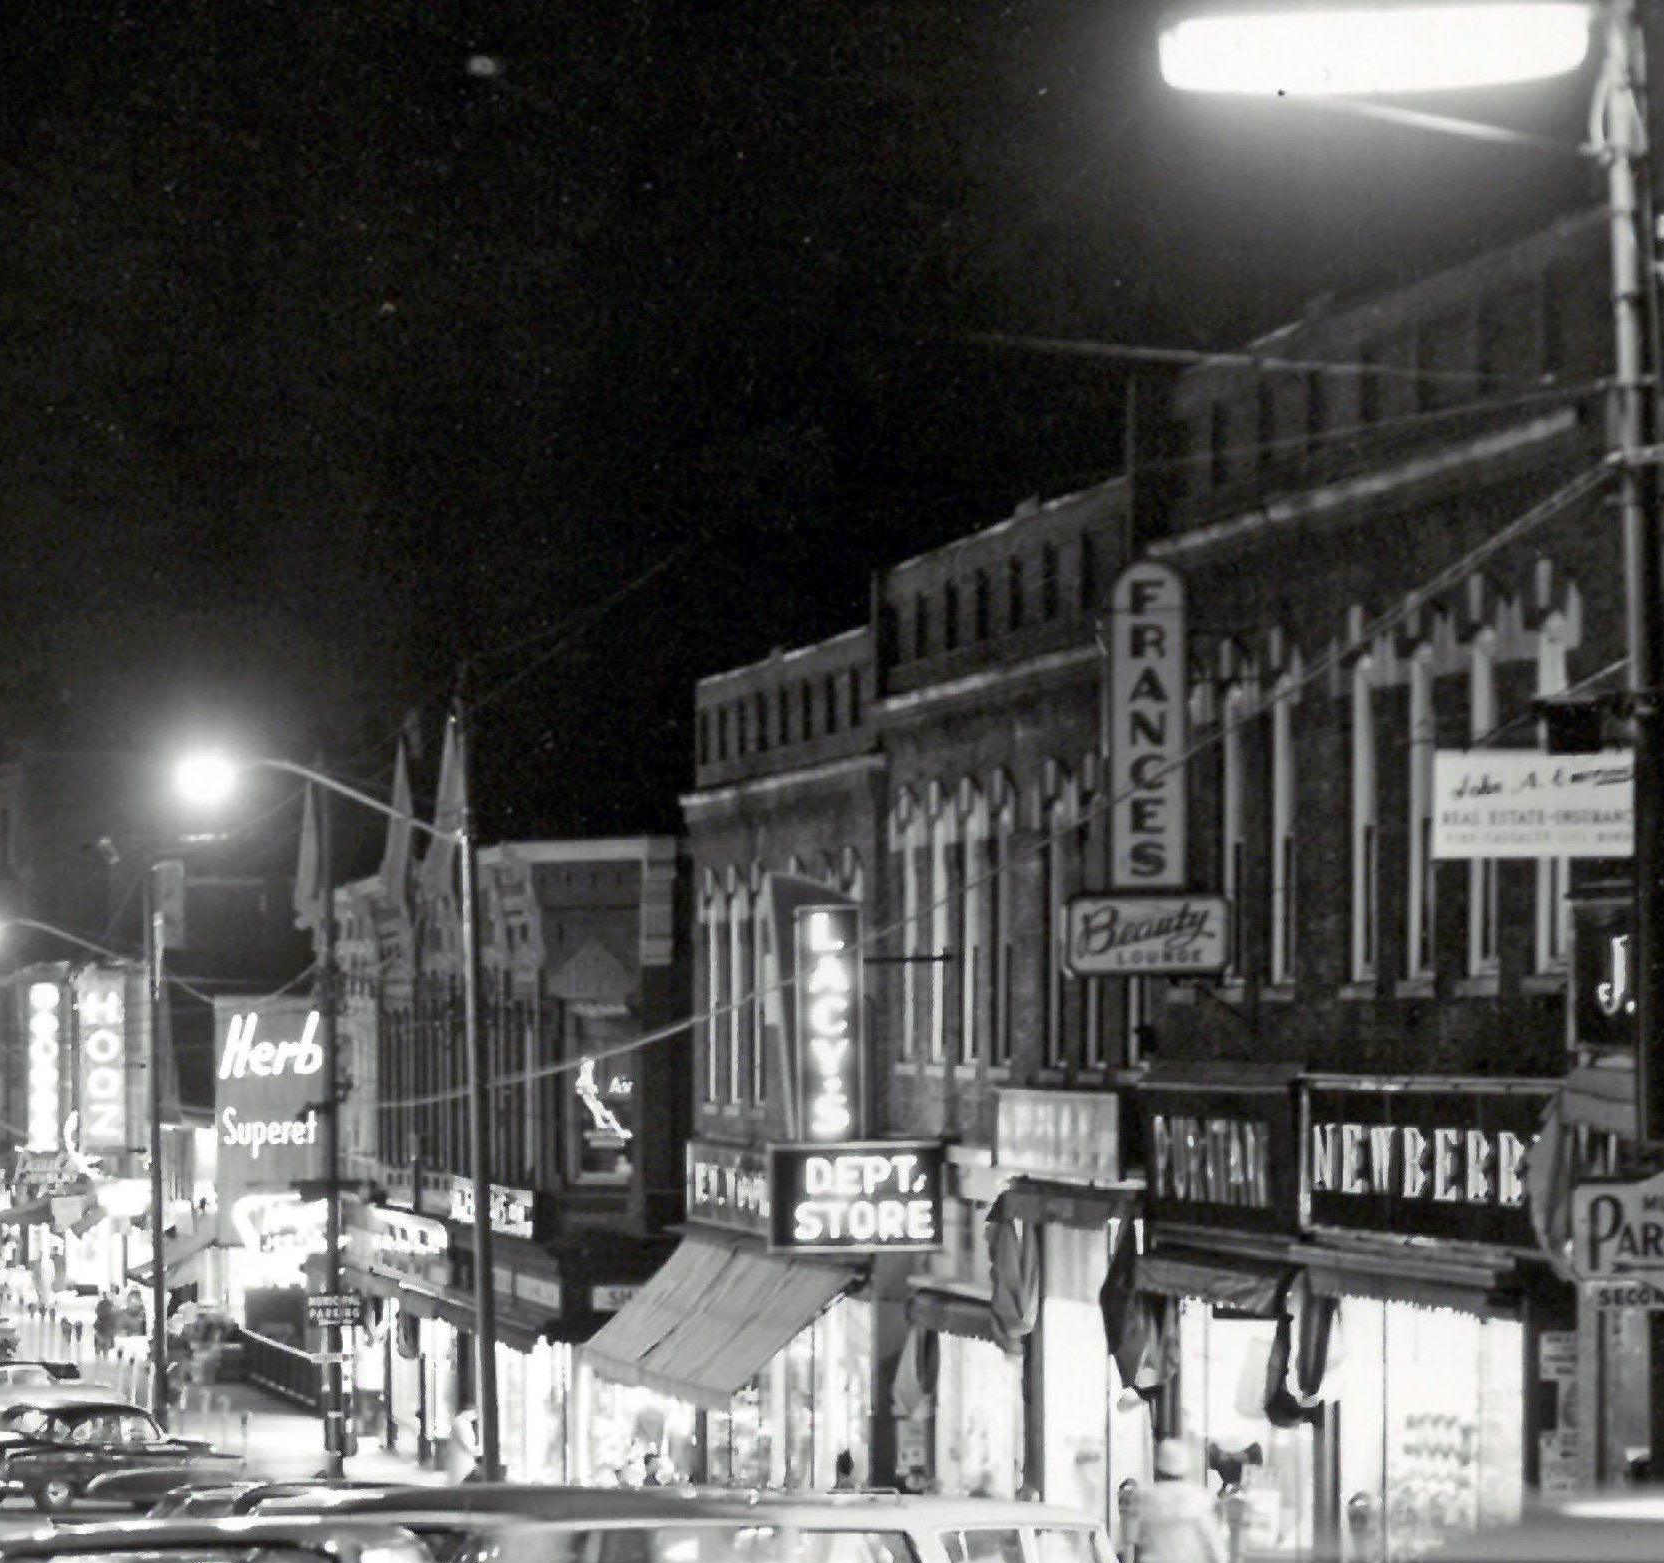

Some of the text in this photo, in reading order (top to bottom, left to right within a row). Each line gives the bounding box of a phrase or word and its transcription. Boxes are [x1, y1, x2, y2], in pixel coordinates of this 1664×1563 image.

[1128, 579, 1168, 877] FRANCES
[1078, 903, 1217, 957] Beauty
[1115, 948, 1204, 966] LOUNGE
[1312, 1123, 1540, 1208] NEWBERR
[793, 1199, 936, 1242] STORE
